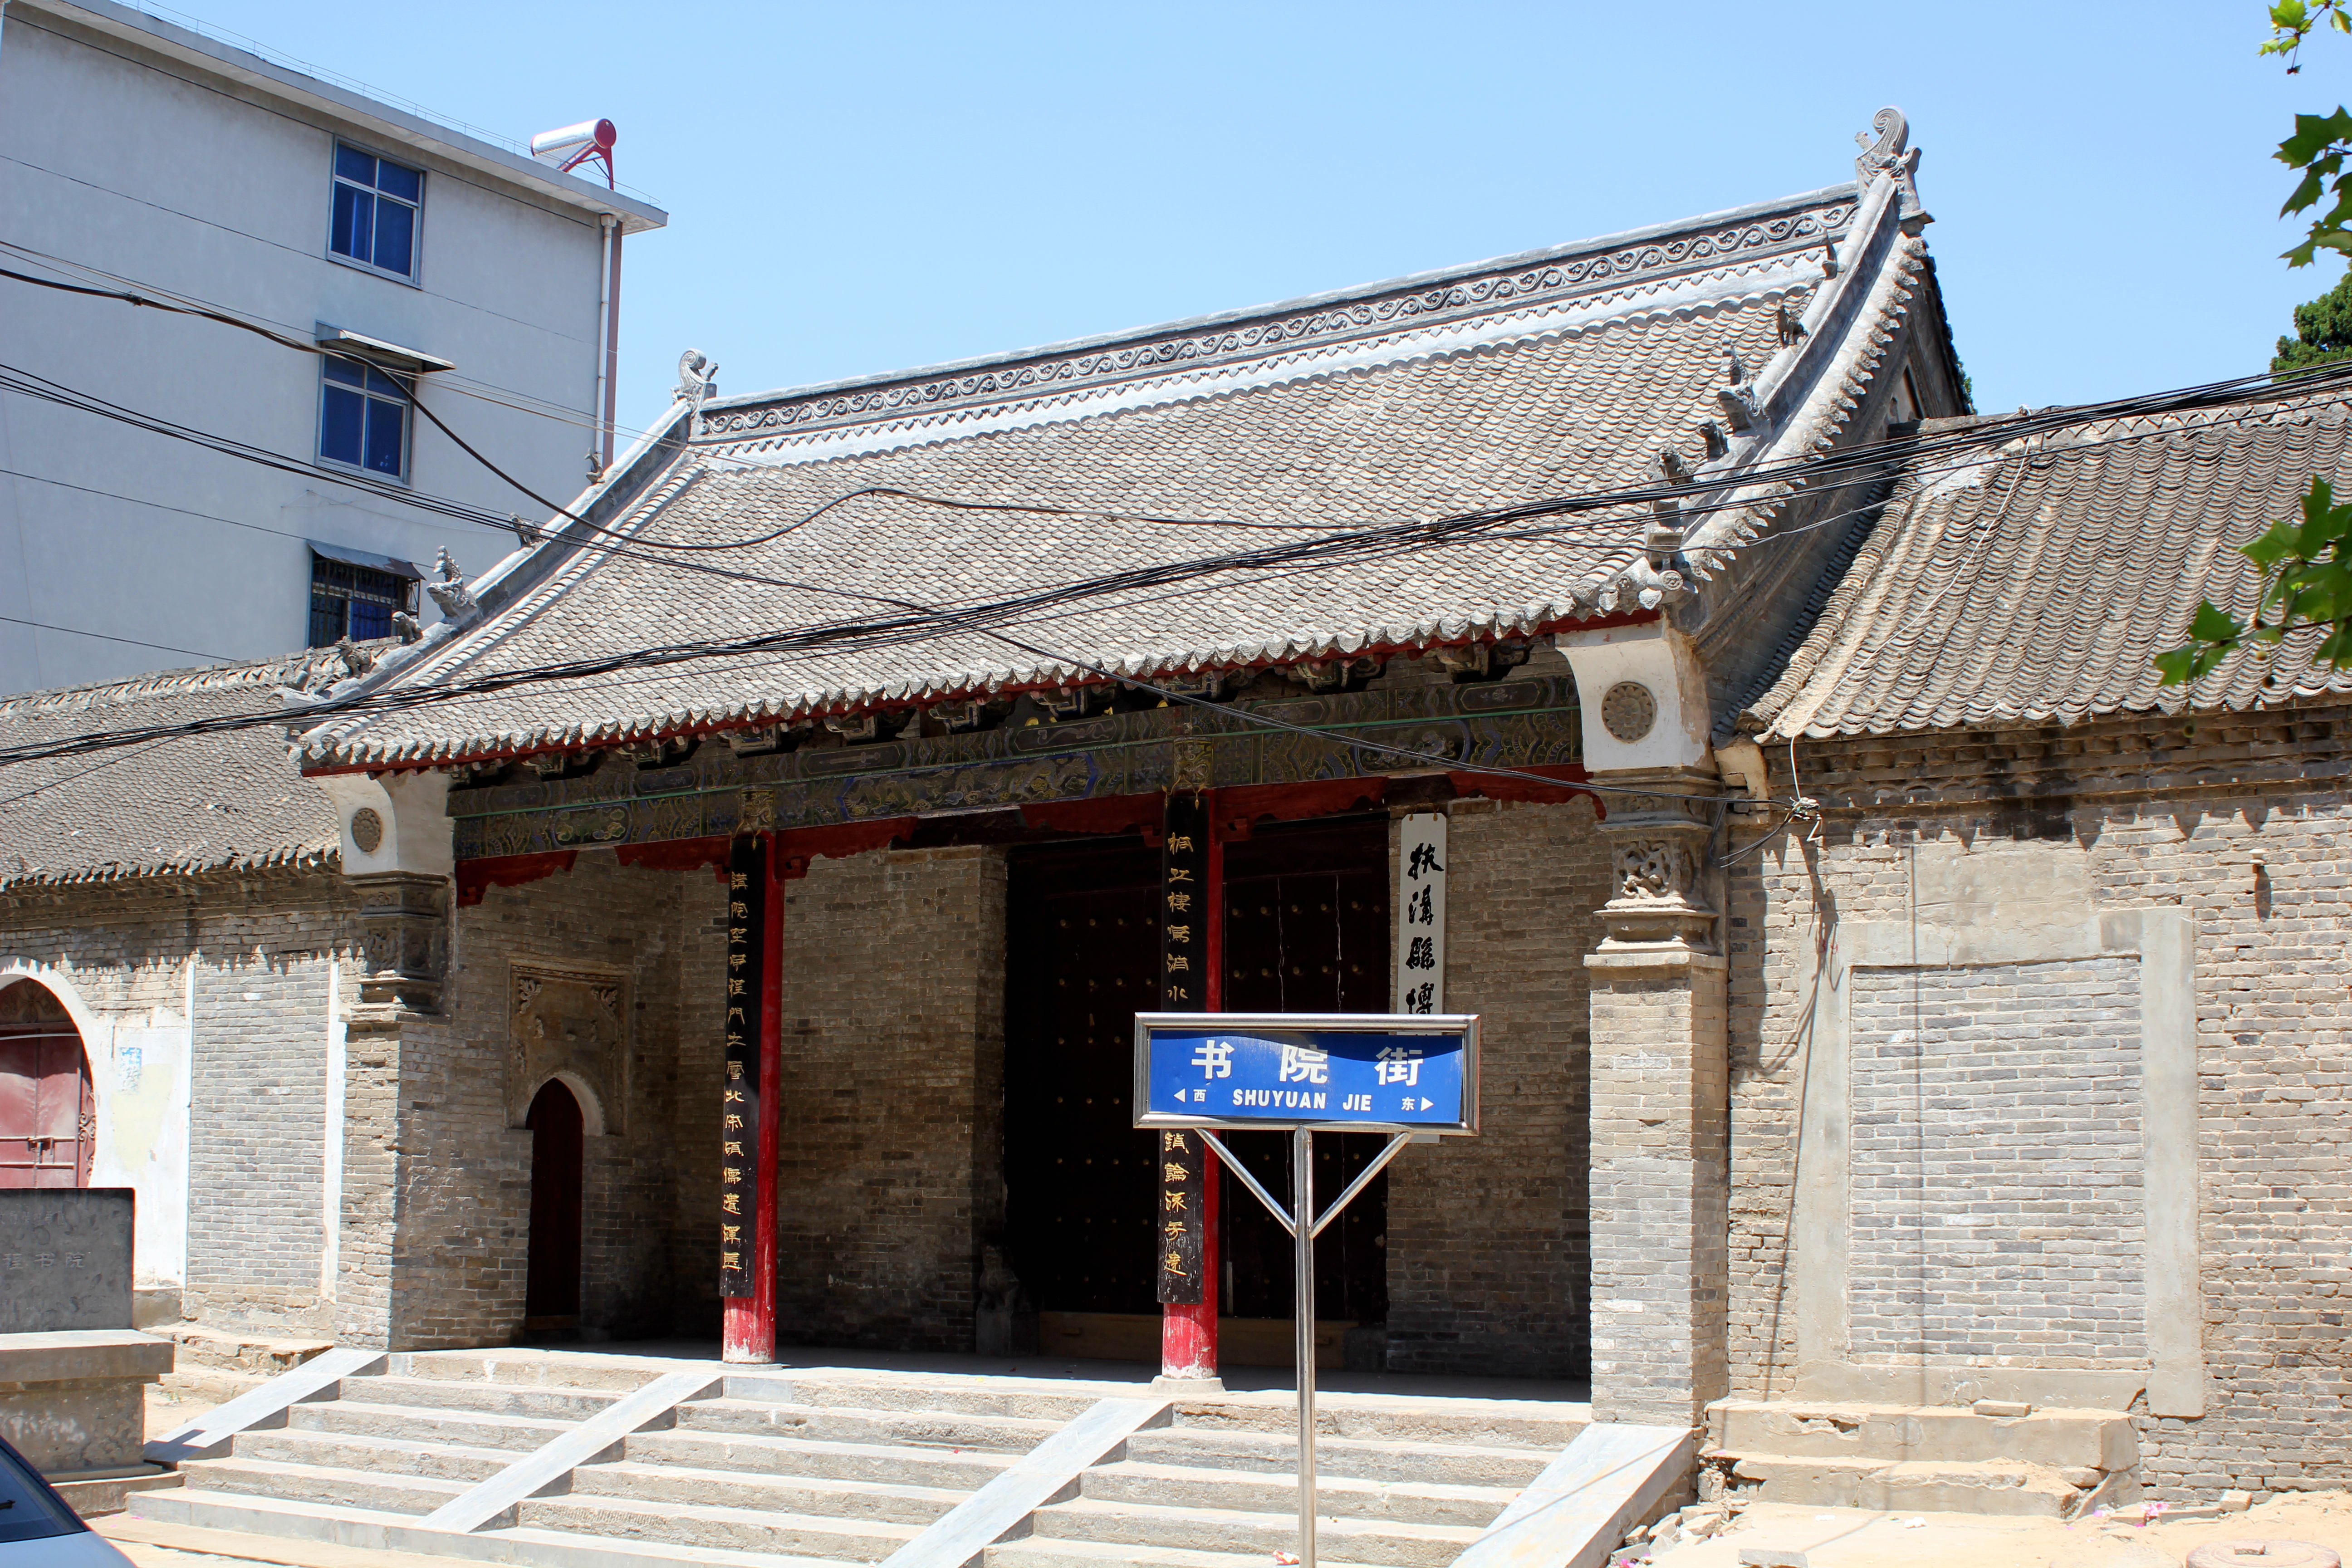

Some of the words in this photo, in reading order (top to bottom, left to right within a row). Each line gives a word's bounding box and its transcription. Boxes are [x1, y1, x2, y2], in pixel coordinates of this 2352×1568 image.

[1406, 842, 1445, 1041] 扶溝縣博
[1191, 1039, 1423, 1086] 书院街
[1193, 1089, 1207, 1102] 西
[1233, 1088, 1326, 1109] SHUYUAN
[1343, 1094, 1372, 1111] JIE
[1401, 1097, 1415, 1111] 东
